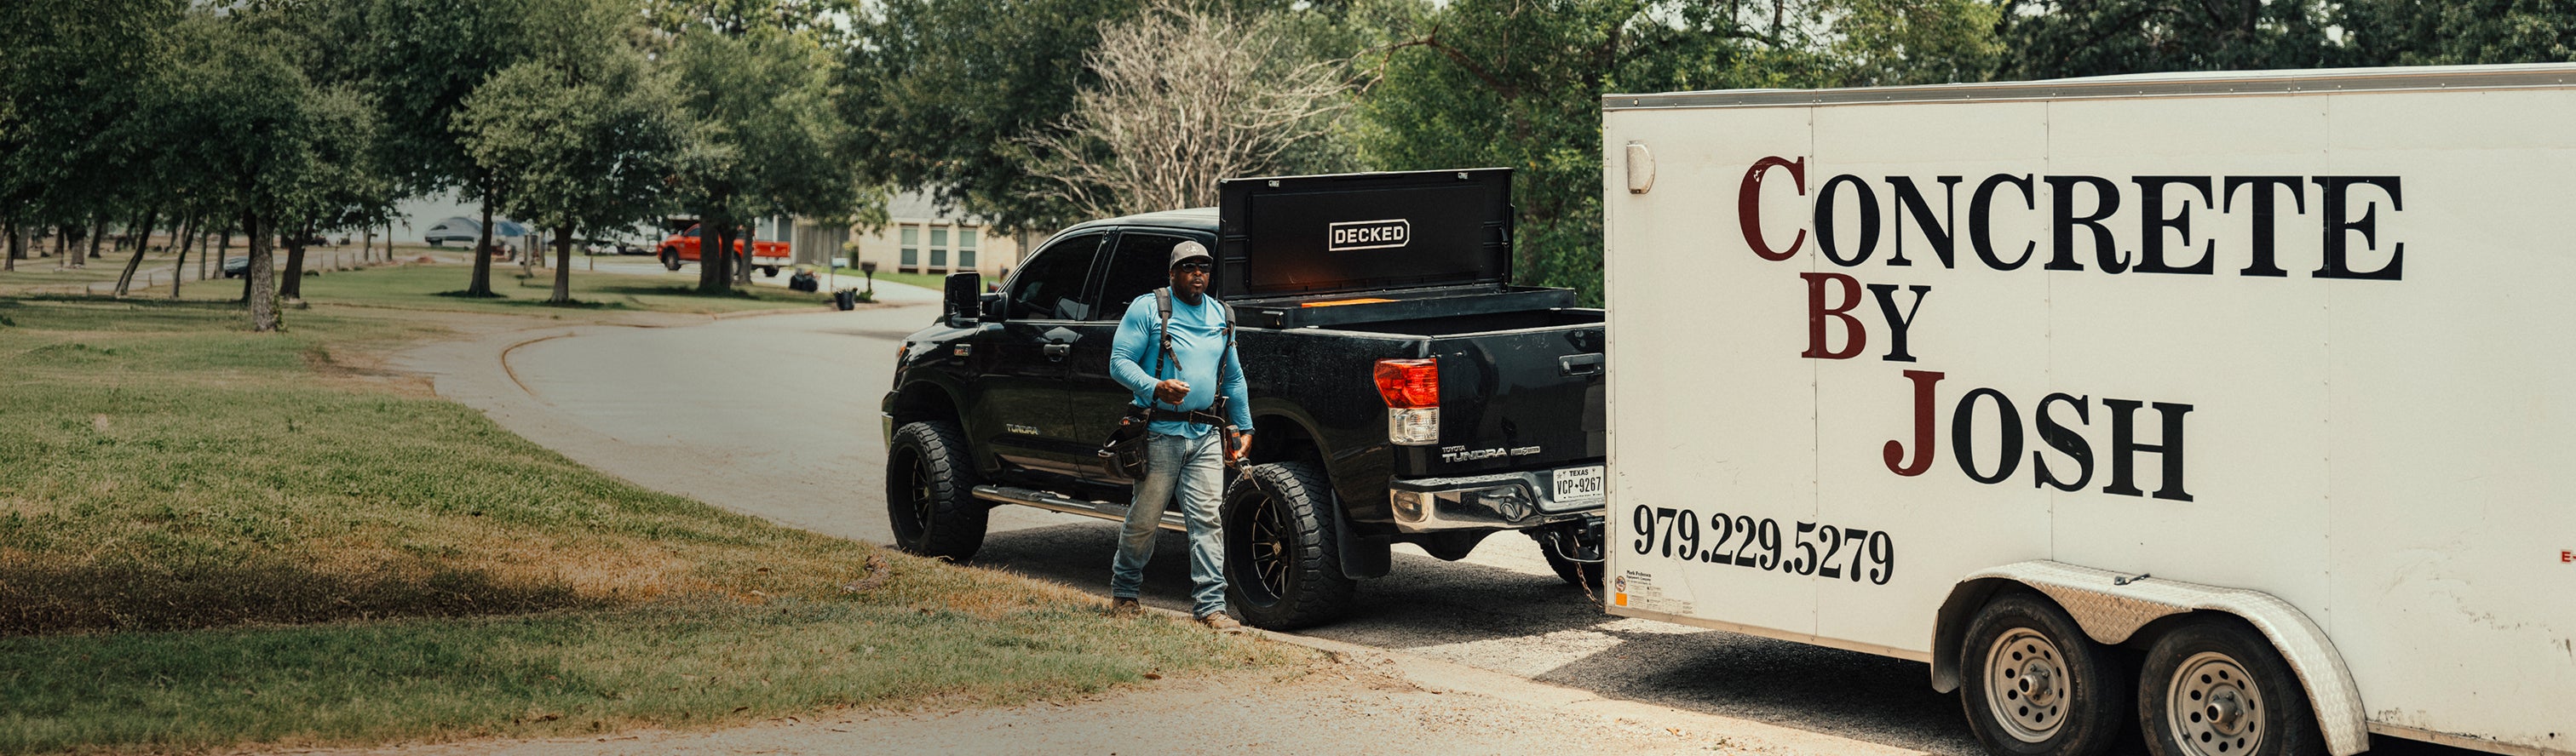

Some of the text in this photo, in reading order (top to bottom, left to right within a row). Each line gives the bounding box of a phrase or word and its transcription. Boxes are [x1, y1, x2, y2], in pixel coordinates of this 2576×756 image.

[1335, 226, 1405, 243] DECKED
[1739, 156, 2405, 281] CONCRETE
[1800, 272, 1932, 363] BY
[1006, 423, 1039, 435] TUNDRA
[1442, 448, 1507, 463] TUNDRA
[1883, 369, 2194, 503] JOSH
[1633, 504, 1895, 586] 979.229.5279
